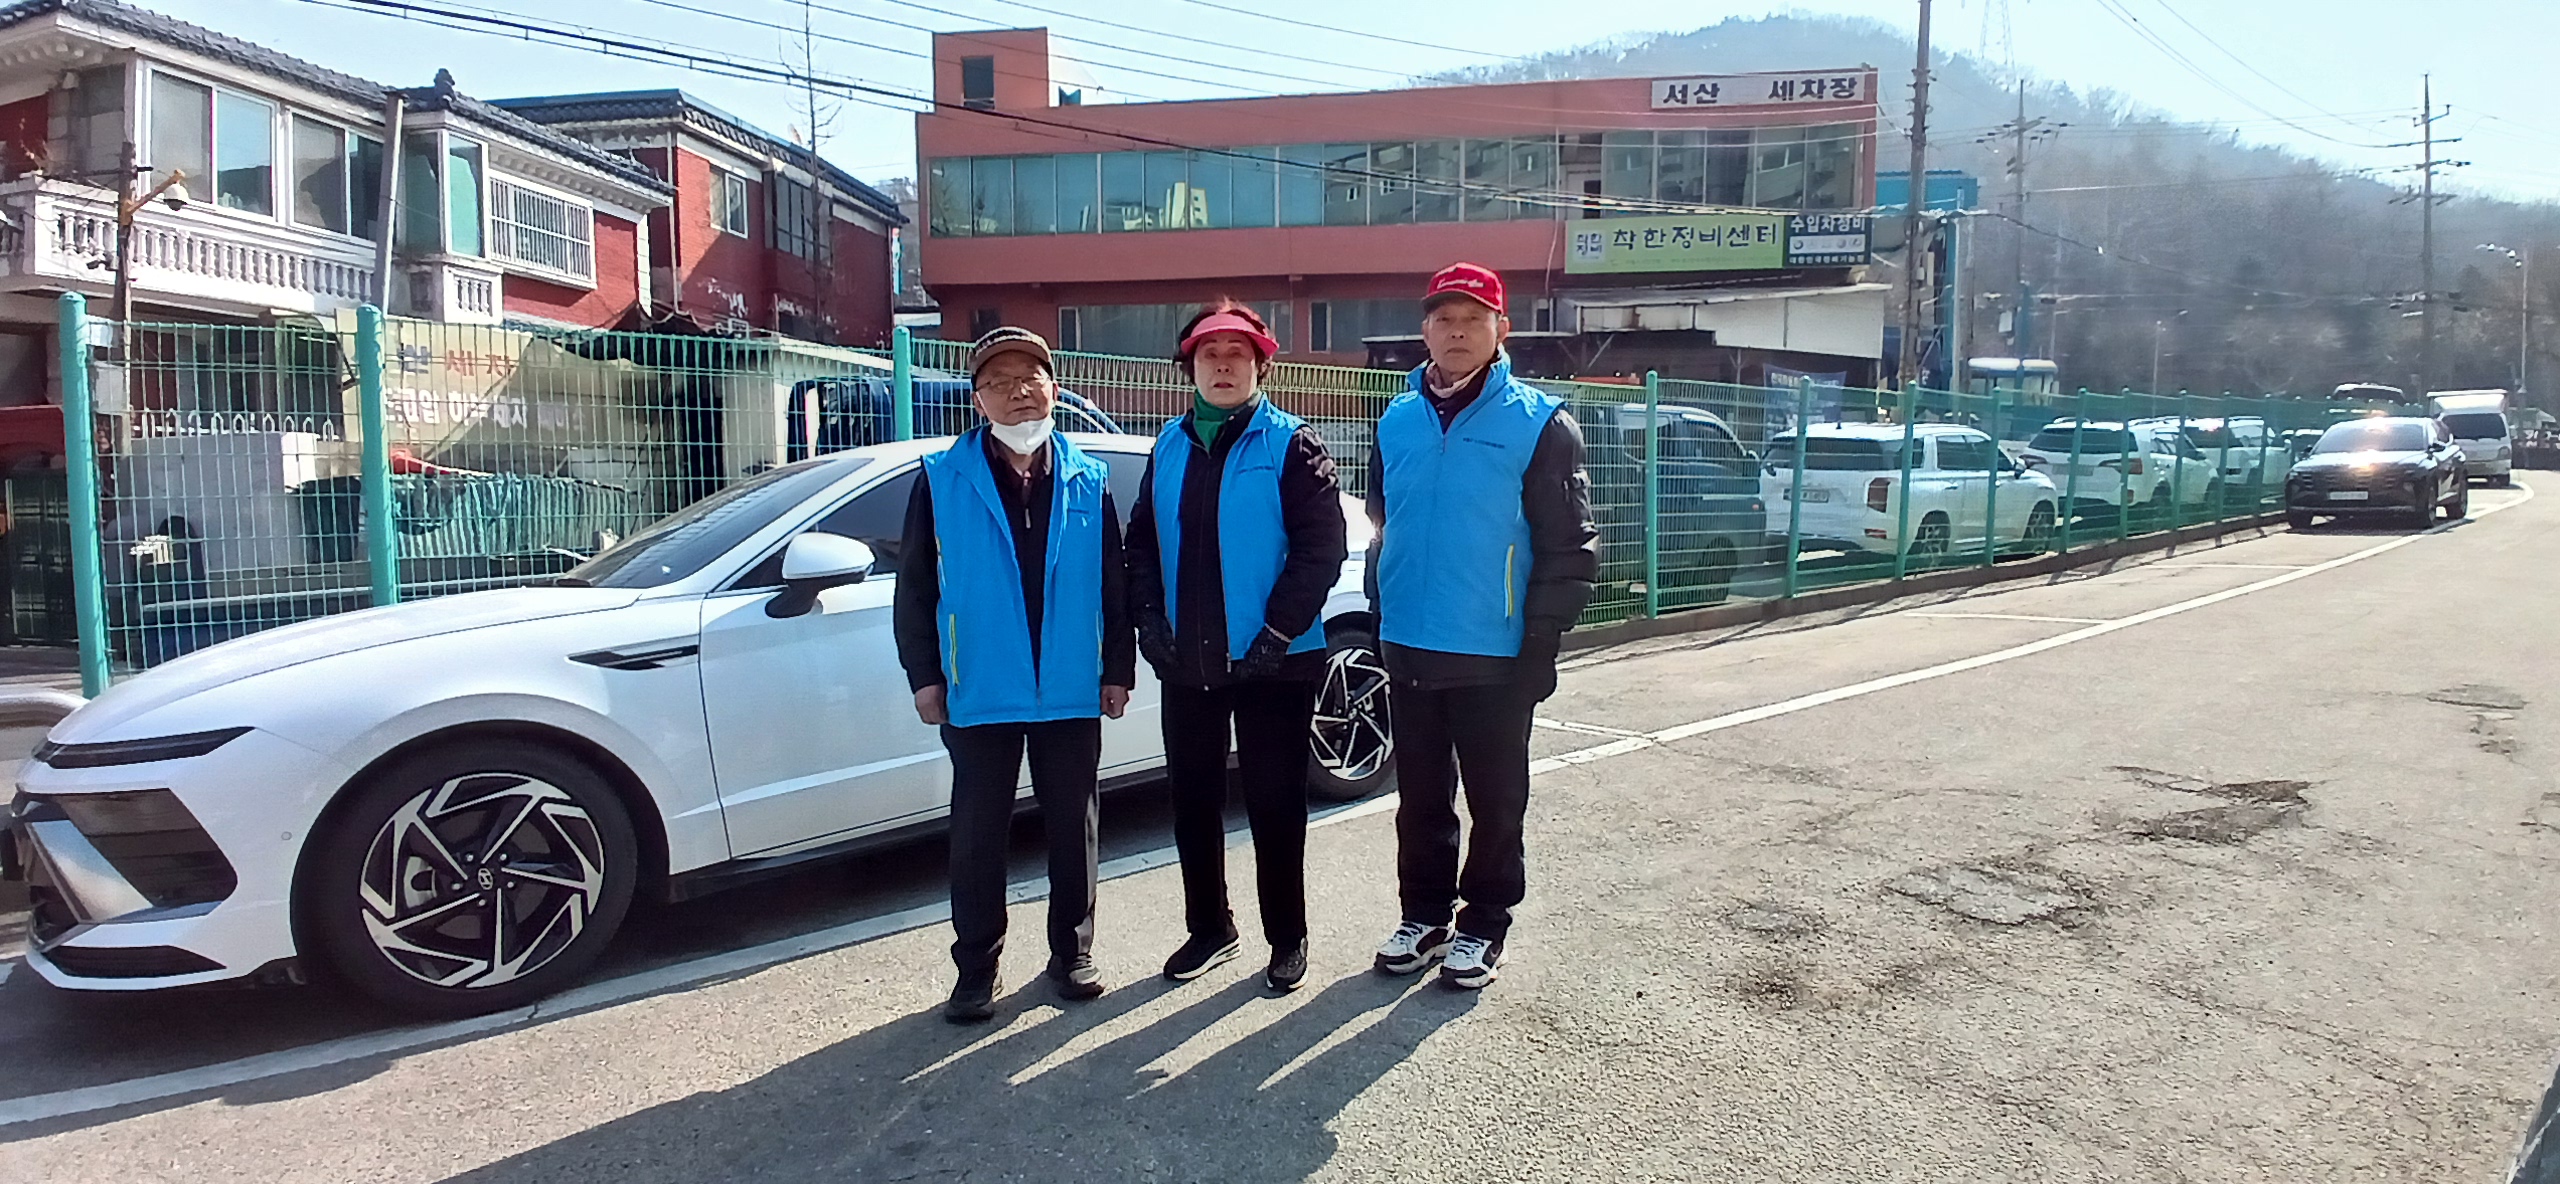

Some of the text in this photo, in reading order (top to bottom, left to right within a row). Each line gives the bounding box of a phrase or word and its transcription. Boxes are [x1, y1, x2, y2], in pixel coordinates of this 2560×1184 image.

[1663, 77, 1858, 105] 서산 세차장
[1612, 222, 1777, 251] 착한정비센터
[1790, 215, 1866, 233] 수입차정비
